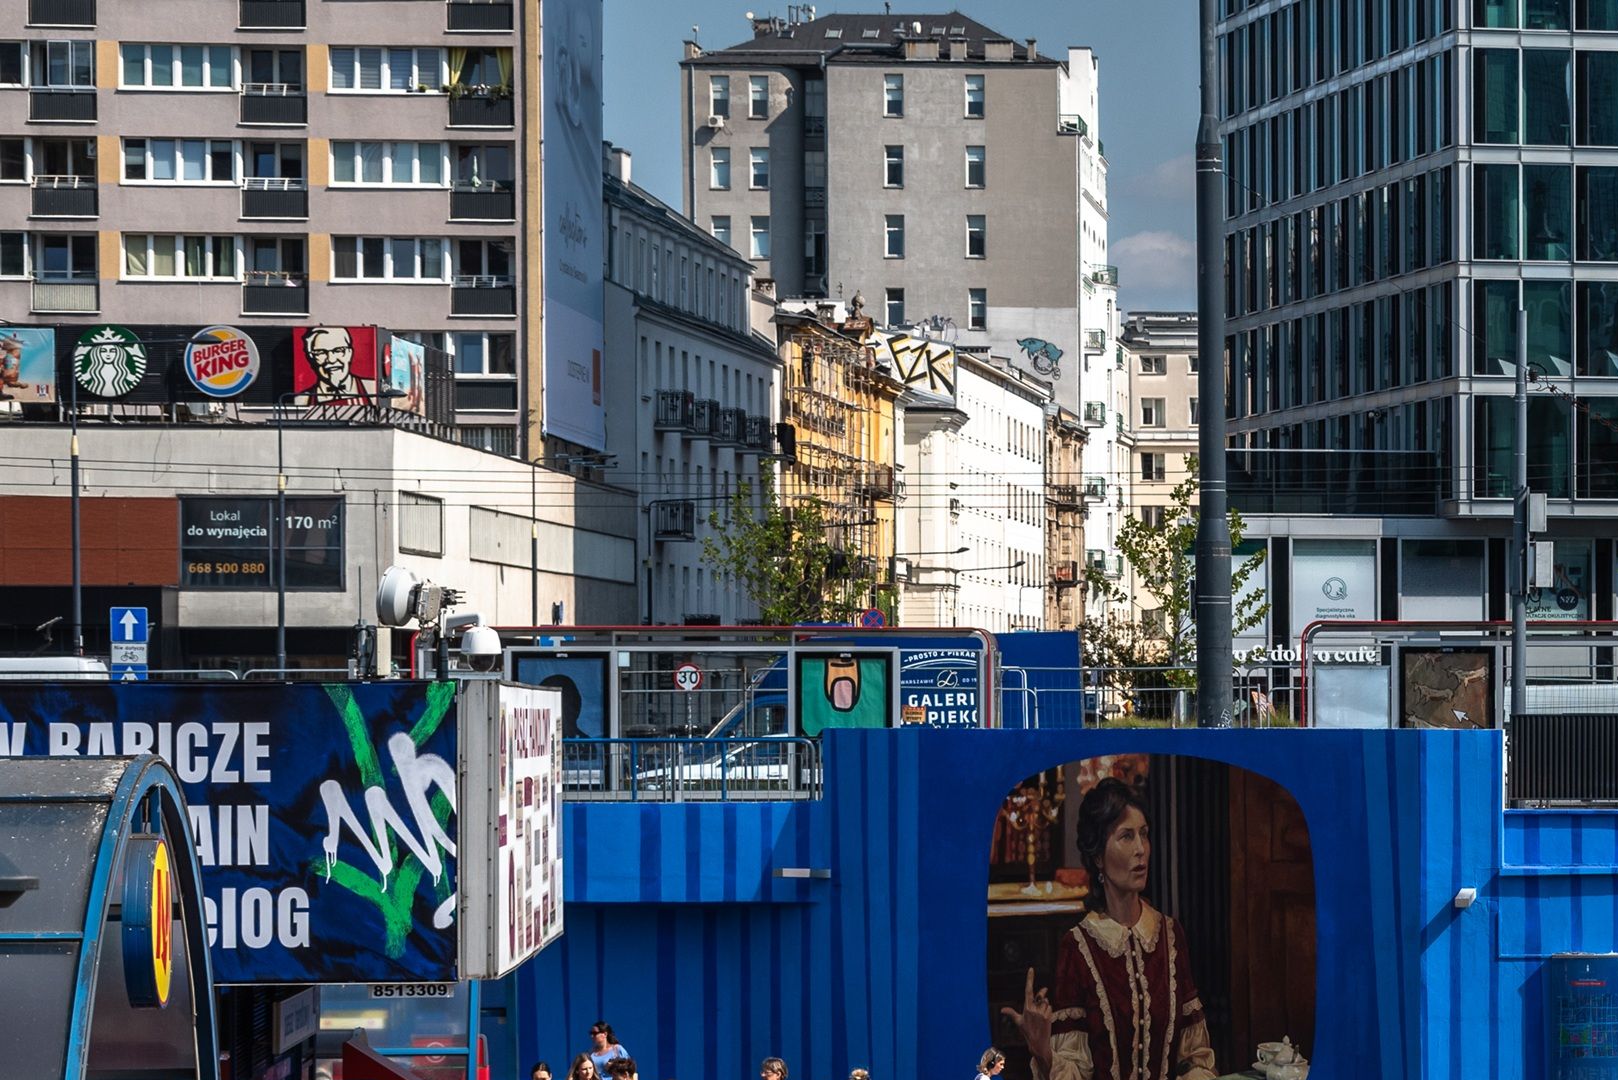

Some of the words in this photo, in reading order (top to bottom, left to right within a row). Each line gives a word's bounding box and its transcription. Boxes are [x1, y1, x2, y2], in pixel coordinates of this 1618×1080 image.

[193, 339, 247, 364] BURGER
[196, 350, 249, 381] KING
[210, 510, 240, 521] Lokal
[285, 516, 313, 529] 170
[187, 525, 204, 536] do
[207, 525, 267, 539] wynajęcia
[188, 562, 212, 574] 668
[215, 562, 239, 574] 500
[242, 562, 265, 574] 880
[908, 651, 938, 662] PROSTO
[678, 671, 698, 684] 30
[908, 693, 975, 707] GALERI
[373, 984, 448, 997] 8513309
